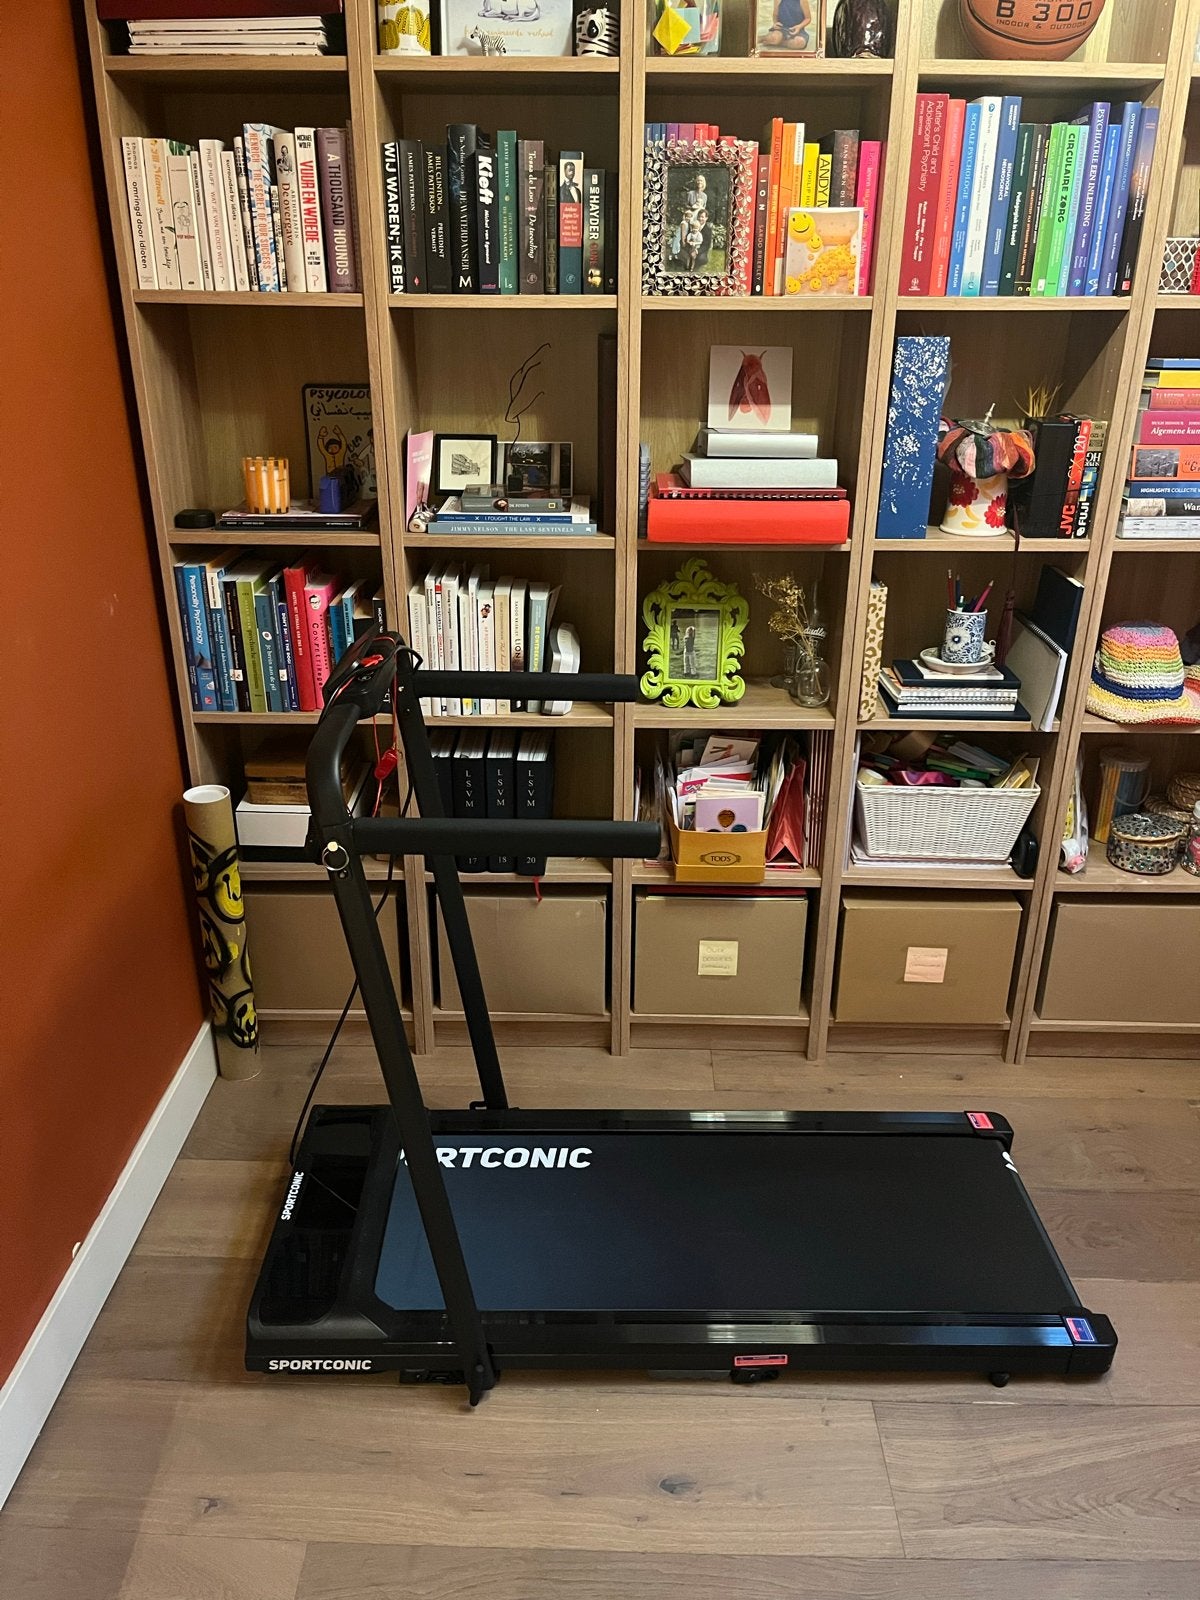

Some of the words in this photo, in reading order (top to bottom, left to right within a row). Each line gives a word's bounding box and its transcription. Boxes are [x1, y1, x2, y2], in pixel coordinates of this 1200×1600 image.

[996, 20, 1030, 28] INDOOR
[1050, 21, 1086, 30] OUTDOOR
[1032, 1, 1092, 22] 300
[922, 100, 936, 148] Adolescent
[933, 100, 944, 133] Rutter's
[967, 112, 978, 146] SOCIALE
[249, 132, 261, 163] HENRICH
[931, 134, 941, 156] Child
[1090, 108, 1106, 164] PSYCHIATRIE
[125, 142, 133, 170] erikson
[205, 148, 213, 168] PHILIP
[327, 153, 339, 162] A
[384, 142, 396, 173] WIJ
[426, 151, 434, 173] JAMES
[434, 156, 442, 171] BILL
[528, 151, 537, 172] Tessa
[929, 157, 938, 174] and
[1061, 132, 1076, 193] CIRCULAIRE
[1120, 113, 1136, 191] ONTWIKKELINGSPSYCHOLOGIE
[226, 159, 235, 194] surrounded
[253, 168, 263, 182] THE
[299, 160, 316, 189] VUUR
[477, 155, 495, 205] Kieft
[529, 174, 537, 184] de
[817, 158, 831, 198] ANDY
[865, 167, 873, 187] leven
[917, 149, 931, 192] Psychiatry
[960, 146, 975, 201] PSYCHOLOGIE
[996, 158, 1009, 201] NEUROSCIENCE
[1002, 162, 1013, 198] BEHAVIORAL
[1088, 164, 1098, 182] EEN
[131, 181, 142, 217] omringd
[229, 195, 235, 203] by
[254, 184, 265, 210] SECRET
[281, 182, 292, 199] De
[302, 190, 317, 206] EN
[327, 165, 346, 226] THOUSAND
[408, 173, 416, 211] PATTERSON
[427, 174, 436, 214] PATTERSON
[435, 172, 443, 205] CLINTON
[529, 187, 537, 202] Loo
[758, 167, 767, 211] LION
[212, 206, 218, 214] JE
[257, 212, 266, 222] OF
[529, 214, 536, 225] De
[589, 195, 600, 239] HAYDER
[1057, 195, 1068, 224] ZORG
[1081, 182, 1095, 228] INLEIDING
[136, 218, 145, 239] door
[259, 223, 268, 238] OUR
[281, 199, 295, 246] overgave
[303, 206, 320, 243] WOEDE
[333, 228, 350, 276] HOUNDS
[390, 245, 402, 260] IK
[437, 223, 445, 257] PRESIDENT
[458, 205, 471, 271] WATERDANSER
[483, 241, 491, 264] Egmond
[526, 228, 538, 258] tweeling
[1010, 231, 1018, 246] beeld
[139, 240, 149, 269] idioten
[260, 238, 272, 270] SUCCESS
[755, 250, 763, 281] BRIERLEY
[391, 264, 404, 295] BEN
[459, 275, 472, 288] M
[951, 264, 960, 288] PEARSON
[1060, 265, 1068, 288] PEARSON
[1073, 435, 1086, 454] 120
[1151, 427, 1185, 436] Algemene
[1060, 504, 1076, 534] JVC
[1078, 502, 1090, 526] FUJI
[189, 575, 200, 608] Personality
[192, 609, 205, 645] Psychology
[534, 626, 541, 634] DE
[215, 612, 223, 632] Abnormal
[222, 673, 231, 694] Psychology
[466, 770, 474, 808] LSVM
[497, 769, 505, 806] LSVM
[527, 770, 535, 807] LSVM
[526, 856, 536, 864] 20
[400, 1147, 593, 1169] RTCONIC
[281, 1171, 305, 1221] SPORTCONIC
[268, 1359, 372, 1371] SPORTCONIC
